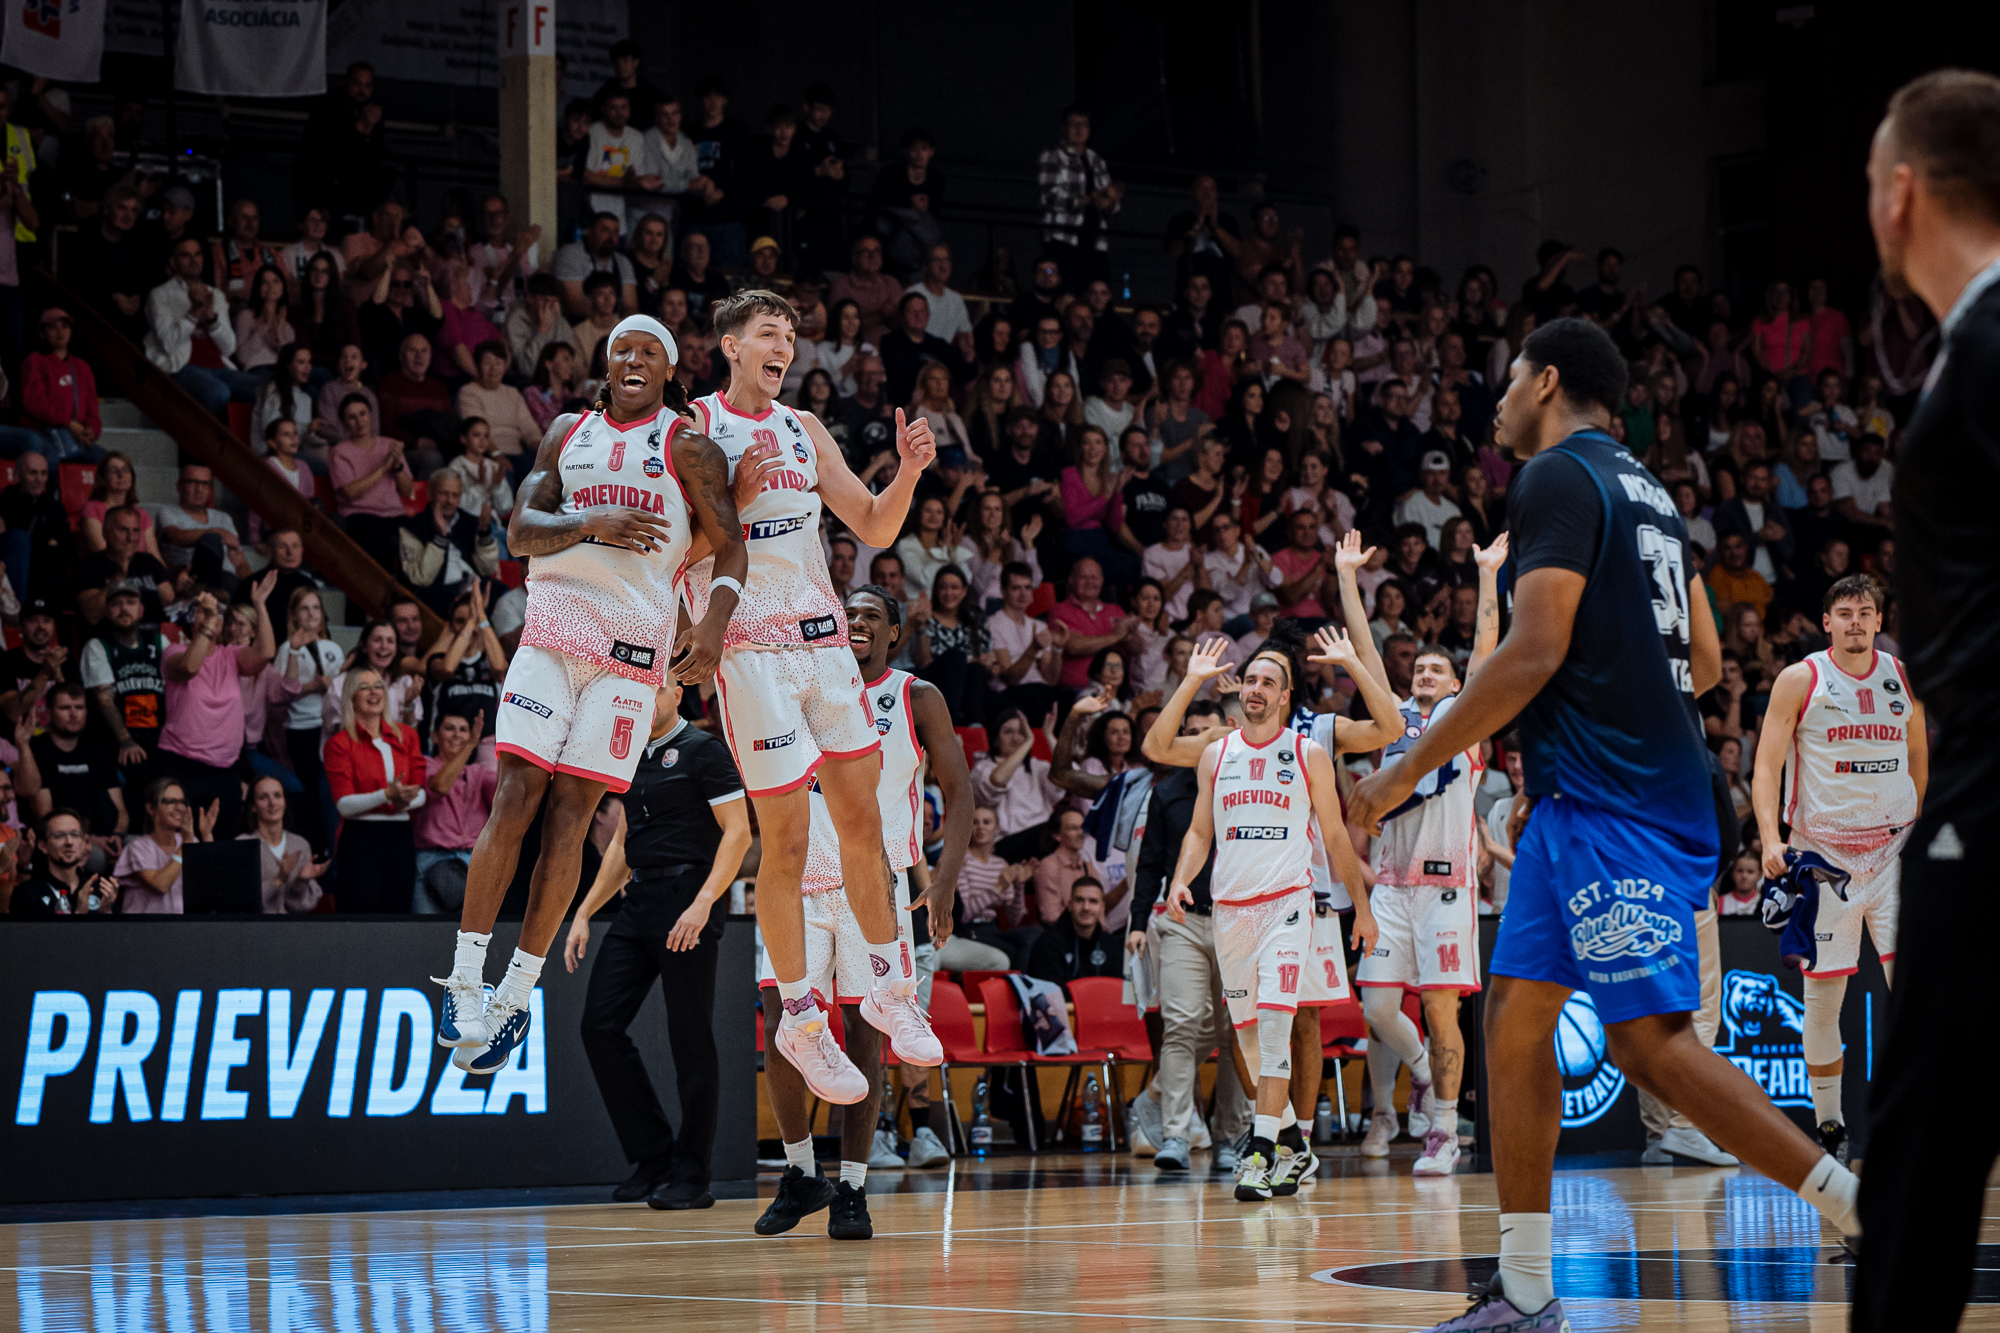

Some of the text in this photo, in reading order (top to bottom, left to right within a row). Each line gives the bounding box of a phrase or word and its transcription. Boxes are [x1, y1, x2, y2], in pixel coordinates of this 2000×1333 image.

[205, 7, 301, 28] ASOCIÁCIA
[508, 8, 519, 49] F
[535, 6, 548, 46] F
[751, 429, 781, 454] 10
[564, 463, 595, 471] PARTNERS
[607, 441, 627, 472] 5
[644, 465, 663, 474] SBL
[572, 484, 666, 516] PRIEVIDZA
[755, 517, 805, 537] TIPOS
[513, 694, 551, 718] TIPOS
[622, 699, 643, 709] ATTIS
[1855, 688, 1876, 715] 11
[609, 715, 634, 760] 5
[1249, 758, 1266, 781] 17
[1854, 760, 1896, 772] TIPOS
[1222, 789, 1291, 812] PRIEVIDZA
[1238, 827, 1285, 839] TIPOS
[1436, 943, 1461, 973] 14
[1277, 963, 1300, 994] 17
[1323, 959, 1340, 989] 2
[1561, 1061, 1621, 1117] ETBALL
[1733, 1056, 1813, 1097] EAR
